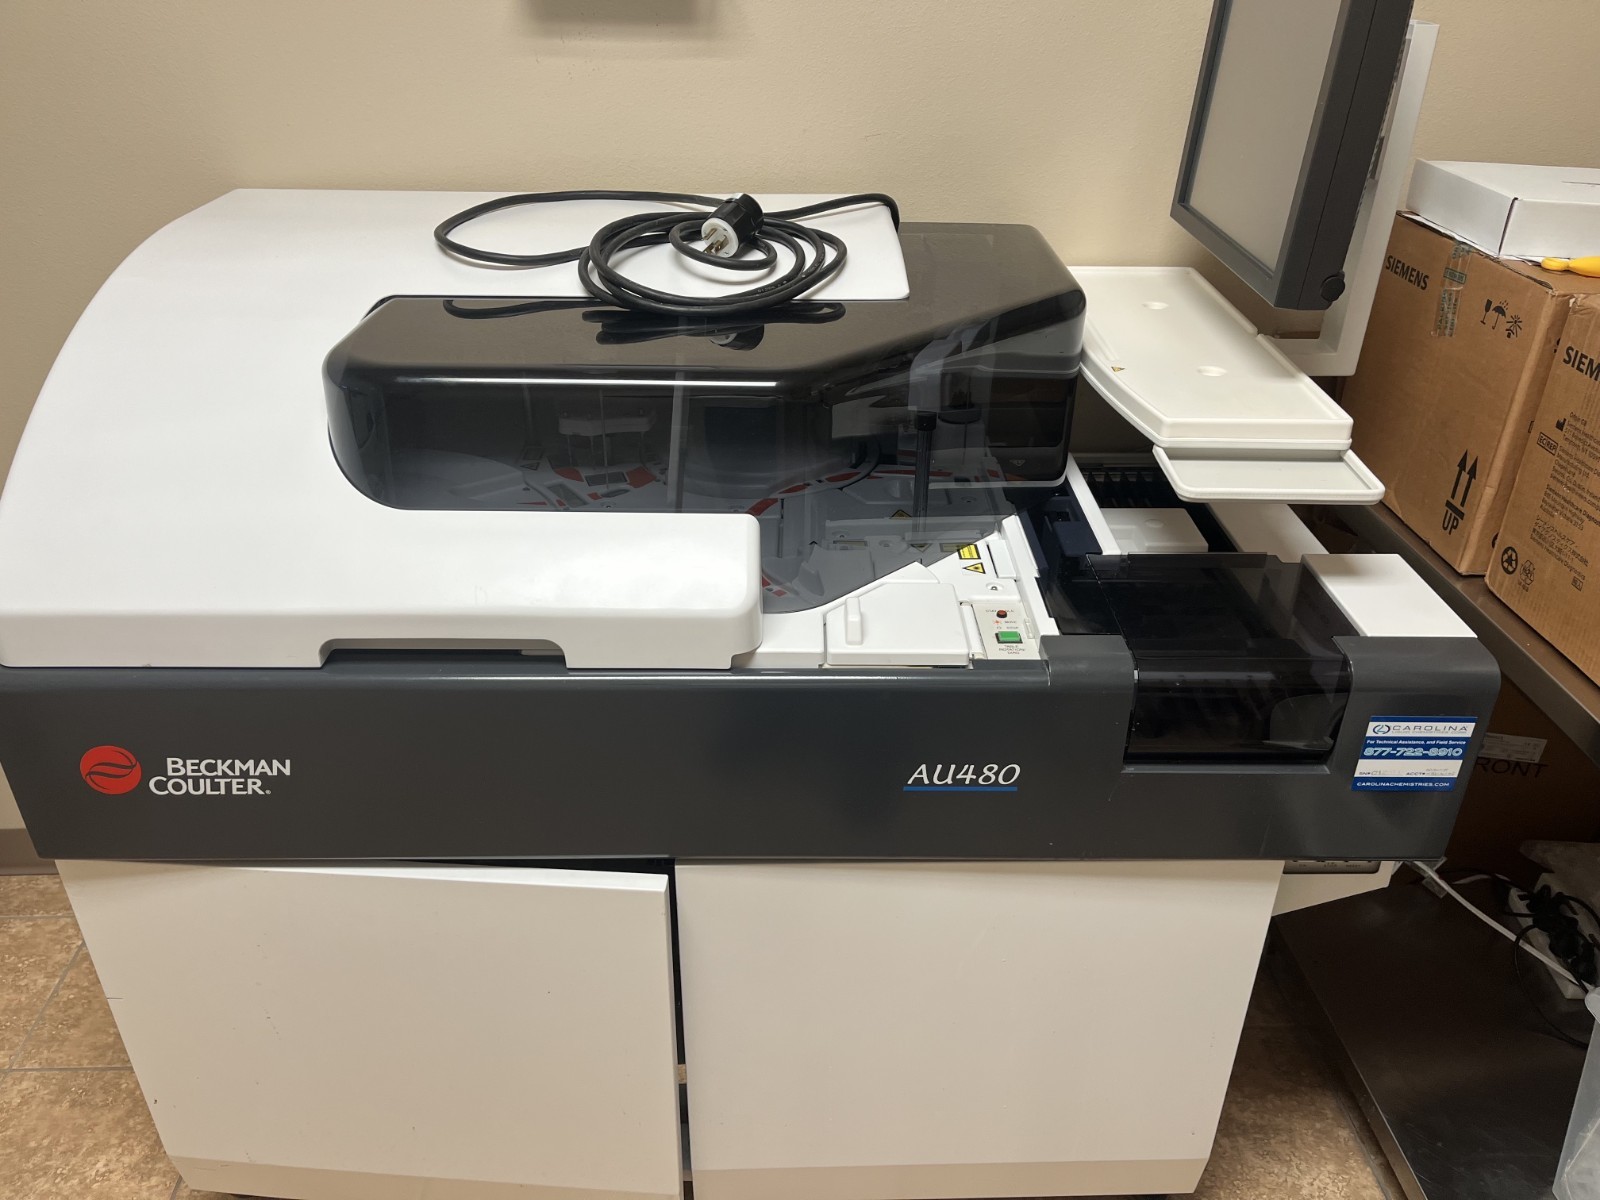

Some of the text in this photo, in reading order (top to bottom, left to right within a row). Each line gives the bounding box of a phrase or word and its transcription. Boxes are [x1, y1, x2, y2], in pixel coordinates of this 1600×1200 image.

[1385, 255, 1430, 291] SIEMENS
[1563, 345, 1600, 381] SIEM
[1442, 509, 1460, 536] UP
[166, 757, 291, 776] BECKMAN
[906, 763, 1021, 785] AU480
[1476, 756, 1549, 778] RONT
